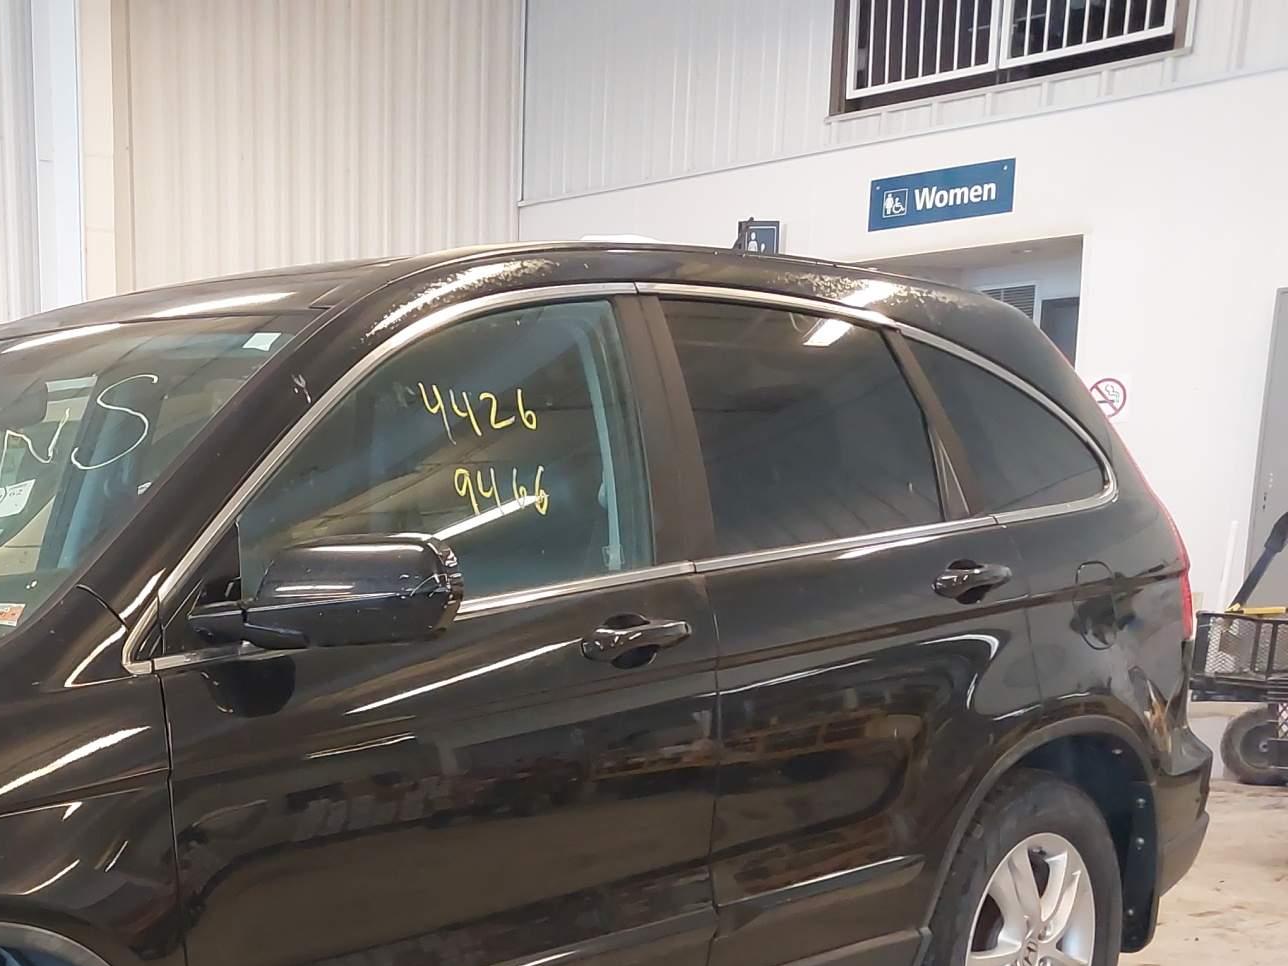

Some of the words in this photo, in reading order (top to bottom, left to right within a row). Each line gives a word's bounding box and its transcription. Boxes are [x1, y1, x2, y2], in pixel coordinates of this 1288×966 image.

[914, 182, 997, 211] Women
[418, 382, 537, 445] 4426
[454, 466, 549, 515] 9466
